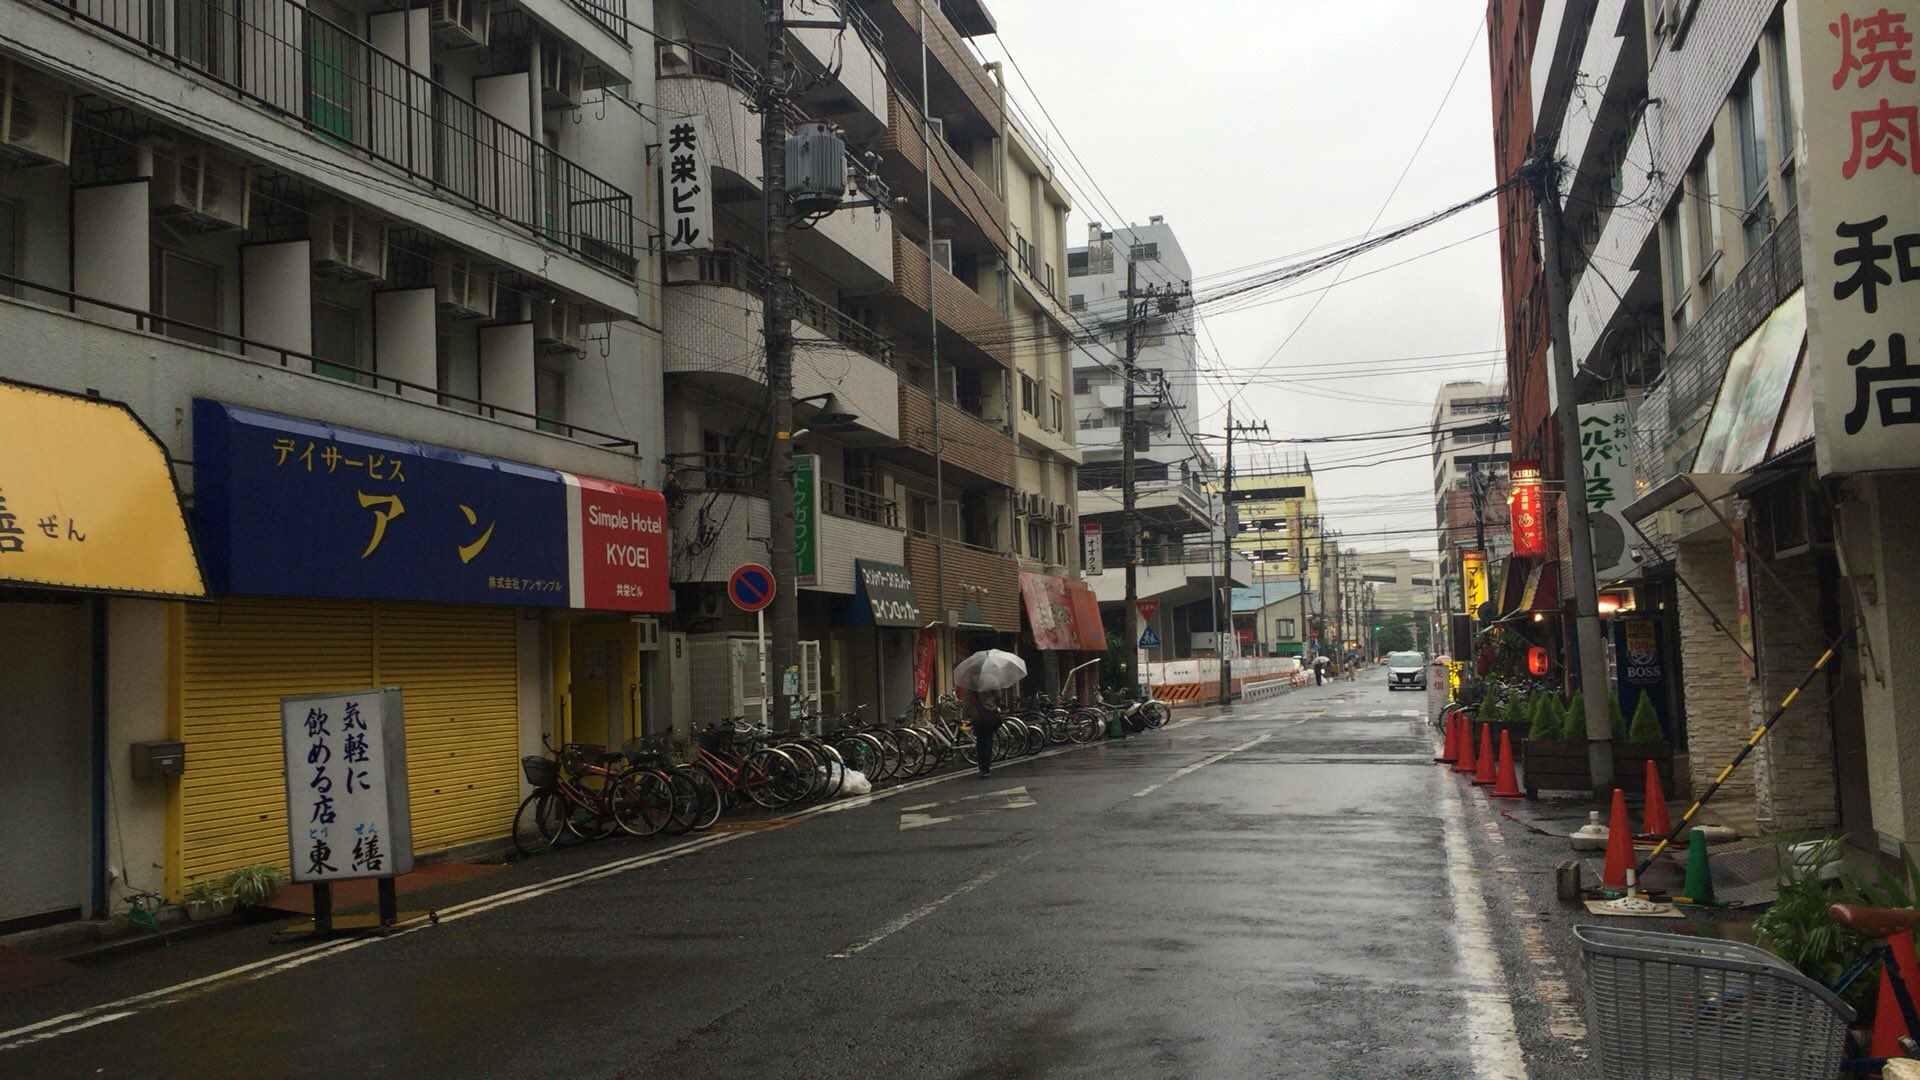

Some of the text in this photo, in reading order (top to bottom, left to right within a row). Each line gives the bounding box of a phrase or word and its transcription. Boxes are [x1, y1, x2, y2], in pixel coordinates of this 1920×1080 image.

[669, 123, 701, 246] 共栄ビル
[1828, 8, 1920, 436] 焼肉 和尚
[1613, 413, 1628, 467] おおいし
[272, 438, 406, 483] デイサービス
[1511, 468, 1540, 479] KIRIN
[1580, 416, 1616, 512] ヘルパーステ
[37, 514, 86, 542] ぜん
[589, 505, 663, 534] Simple Hotel
[1518, 513, 1535, 548] めぐ
[606, 543, 650, 569] KYOEI
[1088, 540, 1096, 573] オオクラ
[488, 576, 520, 590] 株式会社
[616, 583, 644, 598] 共栄ビル
[1467, 566, 1479, 615] マルイチ
[871, 599, 920, 622] コインロッカー
[1627, 666, 1661, 678] BOSS
[342, 702, 370, 795] 気軽に
[304, 707, 336, 825] 飲める店
